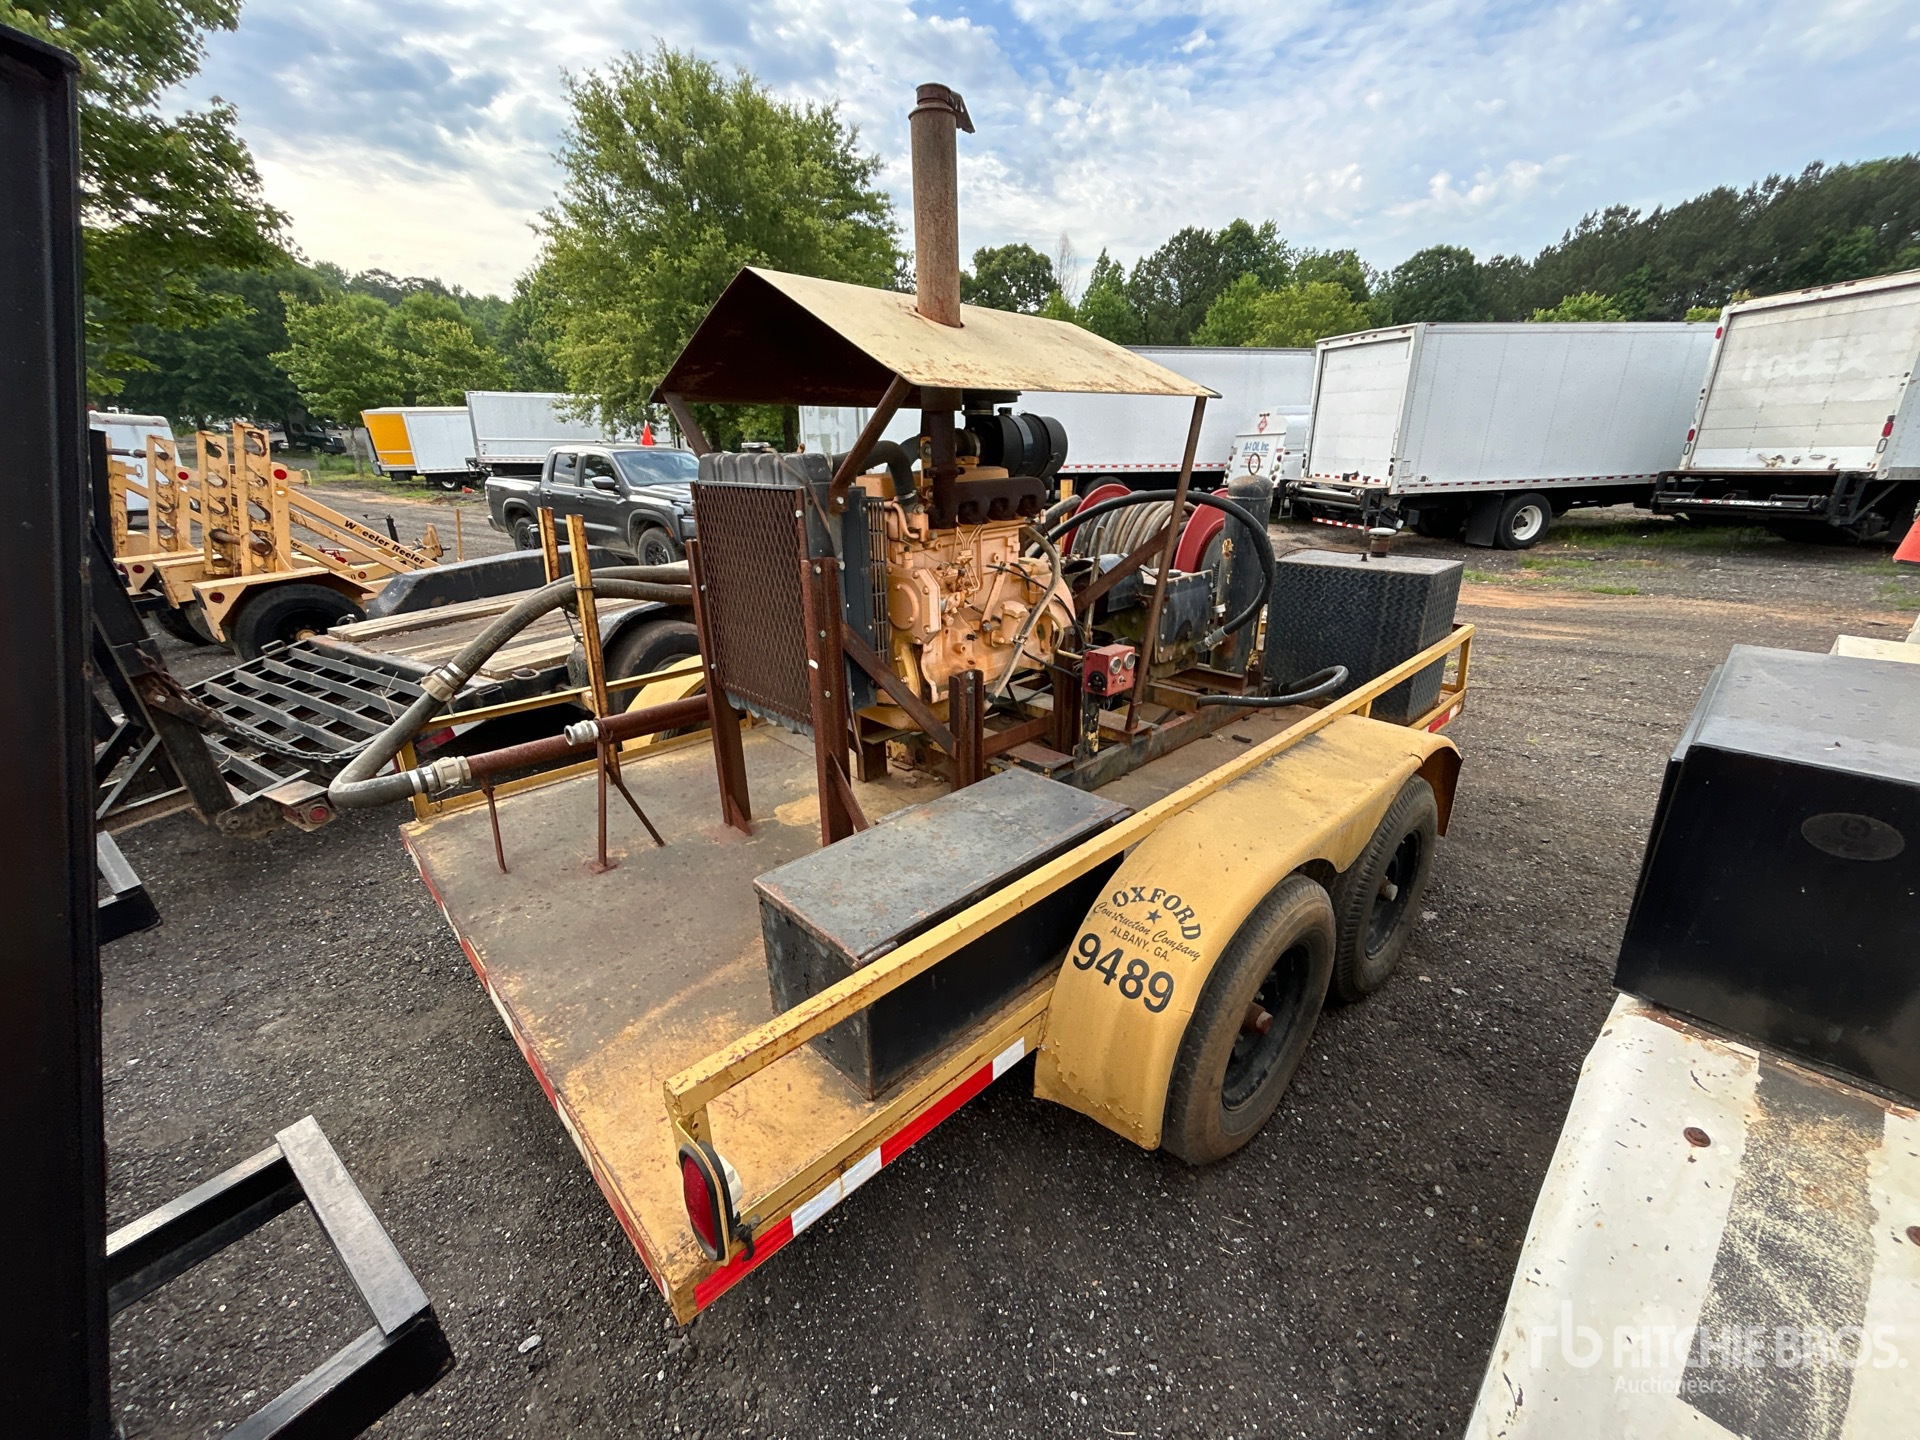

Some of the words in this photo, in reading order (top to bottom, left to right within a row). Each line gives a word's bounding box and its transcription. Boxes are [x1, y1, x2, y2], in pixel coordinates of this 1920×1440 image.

[391, 544, 426, 565] Reeler
[1093, 901, 1151, 936] Construction
[1151, 930, 1201, 962] Company
[1112, 886, 1202, 940] OXFORD
[1073, 933, 1174, 1013] 9489
[1153, 946, 1170, 962] GA.
